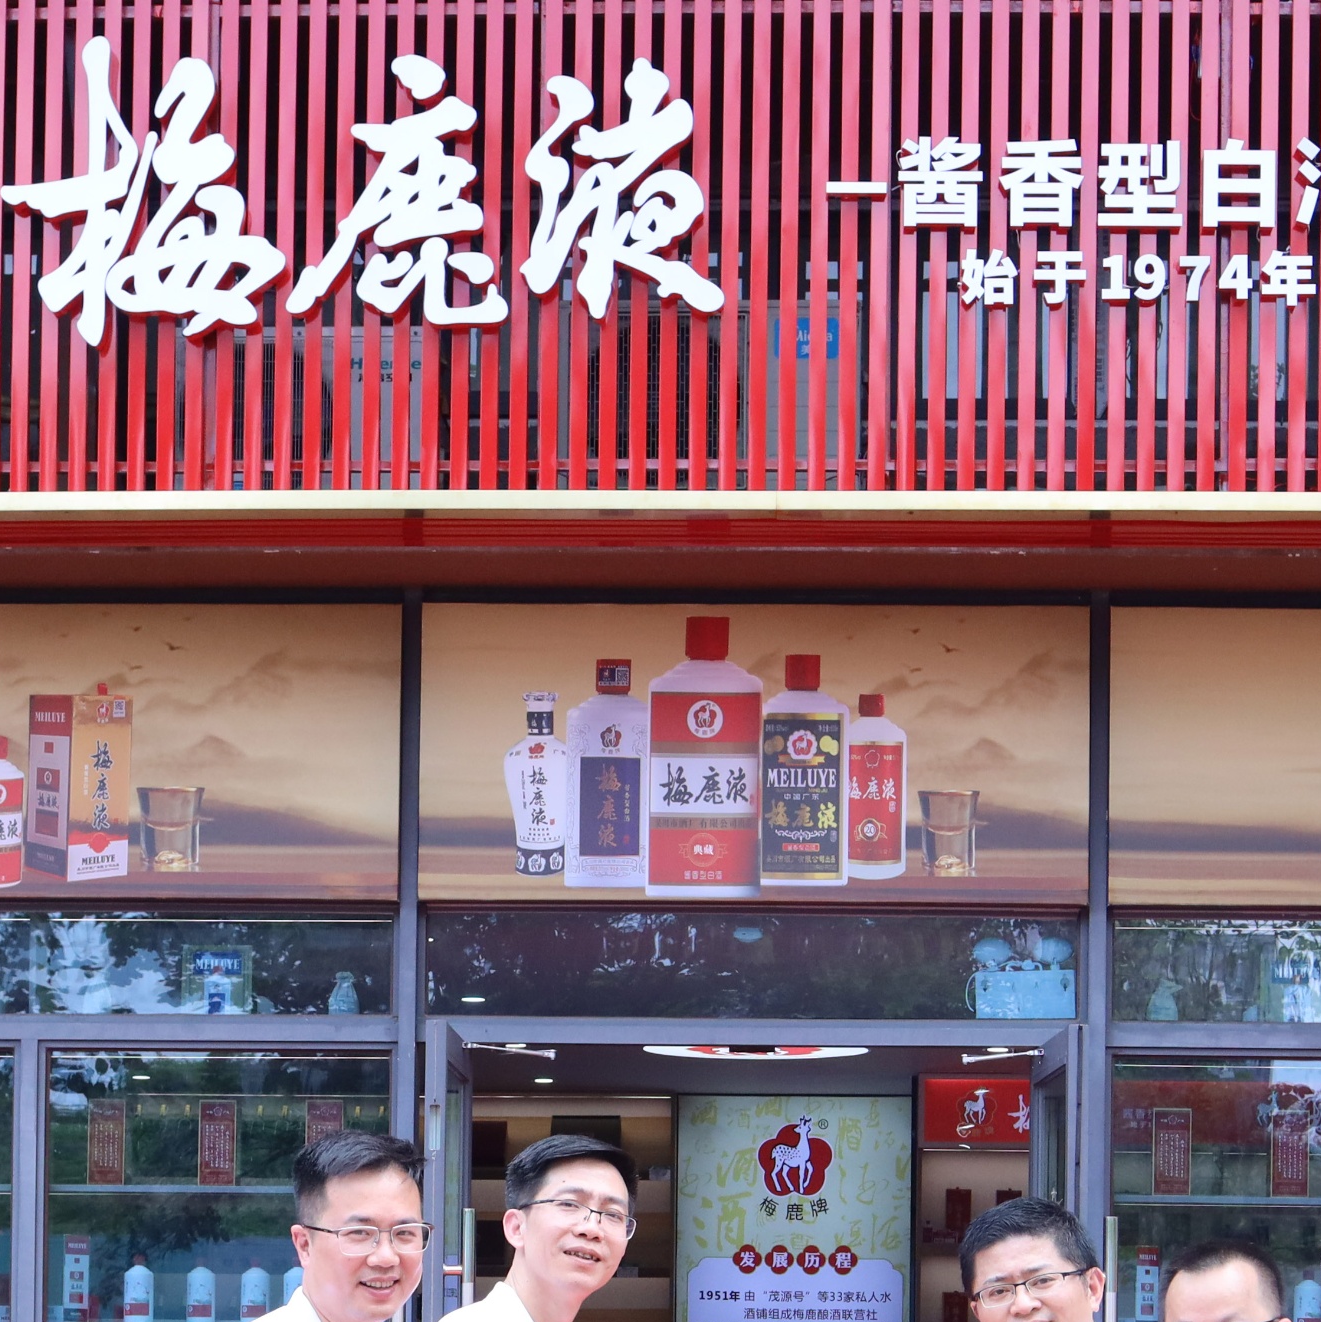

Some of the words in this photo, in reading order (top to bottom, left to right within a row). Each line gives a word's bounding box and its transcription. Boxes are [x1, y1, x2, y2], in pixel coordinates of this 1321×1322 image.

[1, 35, 724, 348] 梅鹿液
[960, 248, 1318, 309] 始于1974年
[34, 711, 66, 723] MEILUYE
[90, 740, 113, 831] 梅鹿液
[659, 762, 750, 808] 梅鹿液
[766, 768, 838, 788] MEILUYE
[527, 765, 549, 826] 梅鹿液
[594, 763, 622, 849] 梅鹿液
[81, 853, 116, 866] MEILUYE
[758, 1196, 830, 1222] 梅鹿牌
[739, 1250, 852, 1269] 发展历程
[699, 1290, 740, 1301] 1951年
[743, 1308, 878, 1321] 酒铺组成梅鹿酿酒联营社
